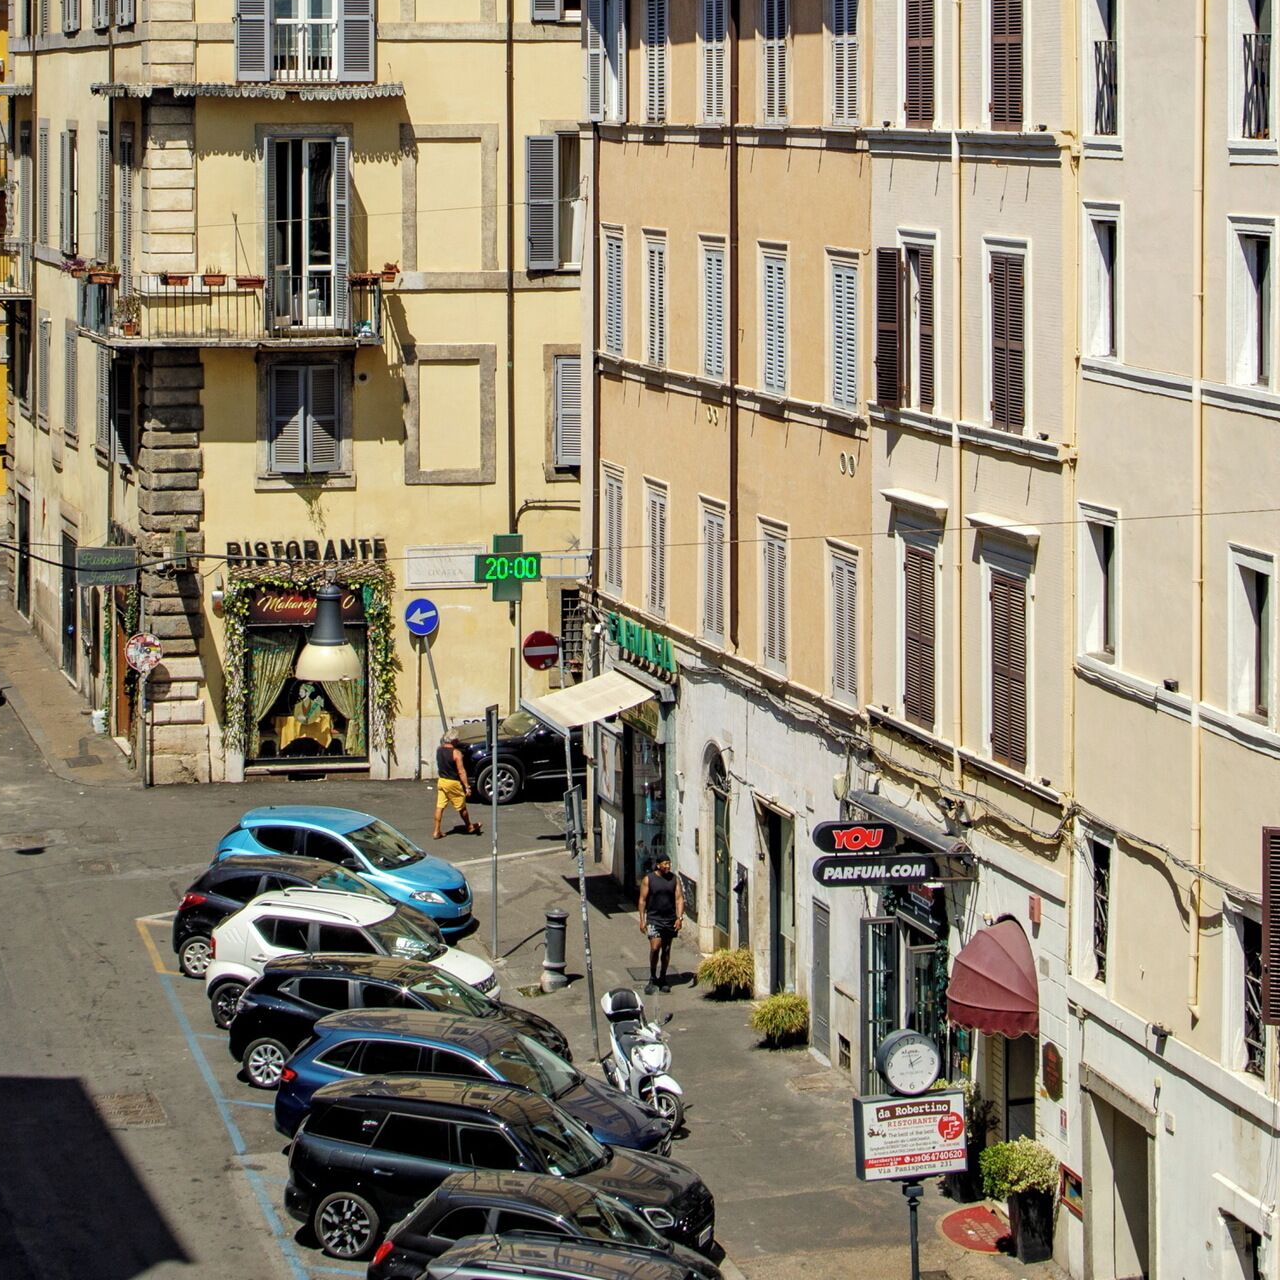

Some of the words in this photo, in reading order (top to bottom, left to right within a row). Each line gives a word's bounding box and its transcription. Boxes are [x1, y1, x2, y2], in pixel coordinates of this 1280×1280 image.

[227, 537, 387, 567] RISTORANTE
[485, 557, 537, 580] 20:00
[257, 595, 318, 616] Maharaj
[832, 826, 884, 851] YOU
[823, 864, 926, 880] PARFUM.COM
[878, 1109, 891, 1119] da
[895, 1102, 949, 1116] Robertino
[887, 1117, 937, 1128] RISTORANTE
[878, 1167, 891, 1175] Via
[895, 1162, 936, 1173] Panisperna
